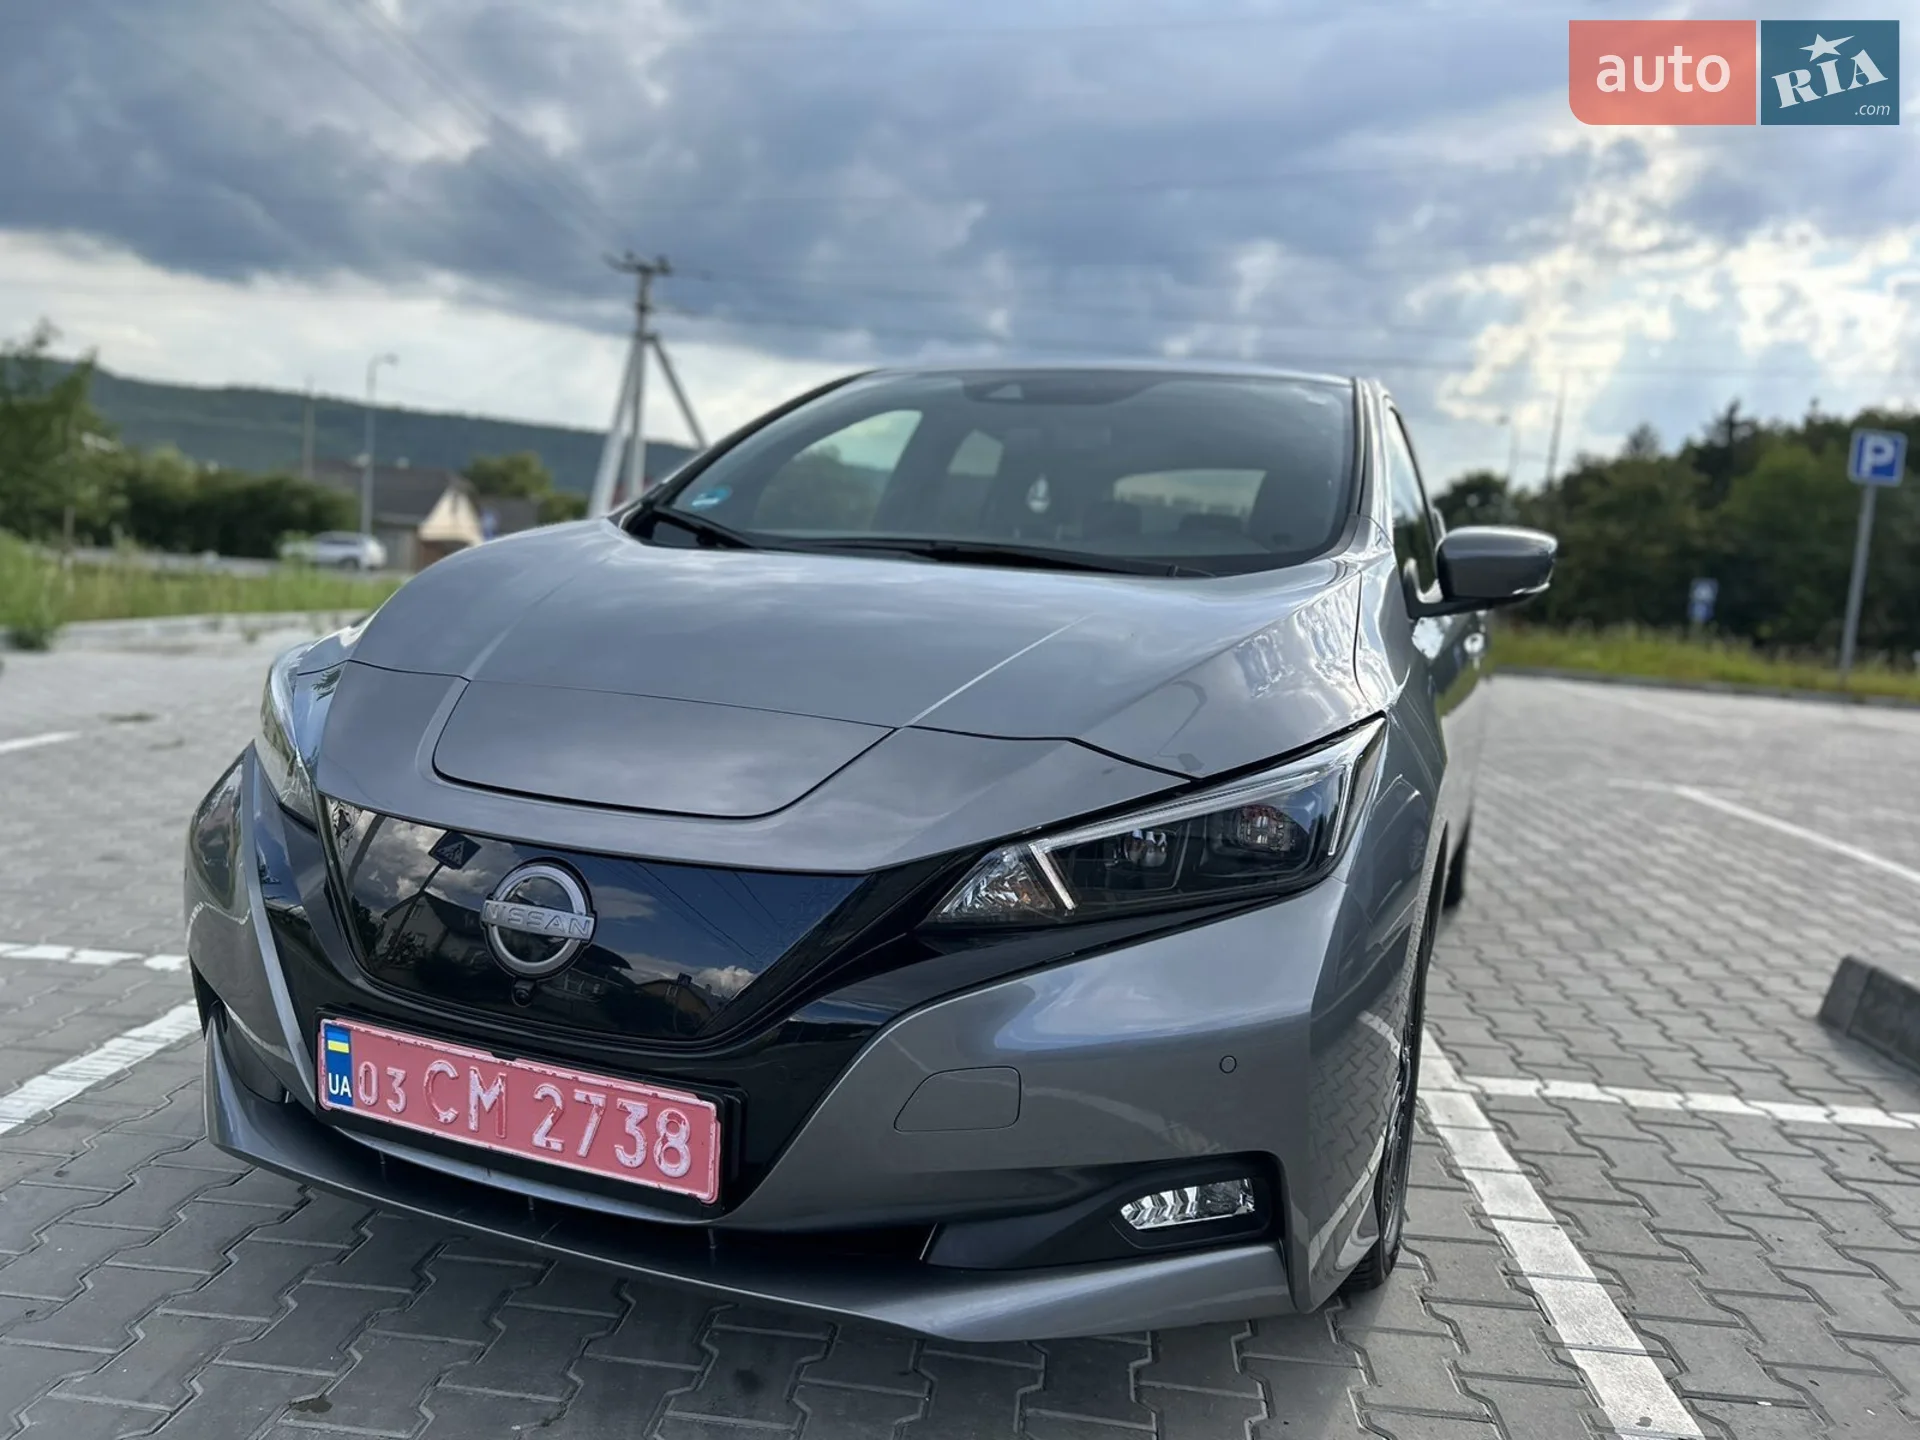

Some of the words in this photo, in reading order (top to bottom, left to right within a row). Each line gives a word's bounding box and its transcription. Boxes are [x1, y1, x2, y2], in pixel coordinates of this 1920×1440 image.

[1859, 435, 1895, 476] P
[485, 902, 590, 937] NISSAN
[328, 1071, 352, 1098] UA
[358, 1061, 408, 1113] 03
[423, 1060, 508, 1139] CM
[531, 1083, 692, 1178] 2738
